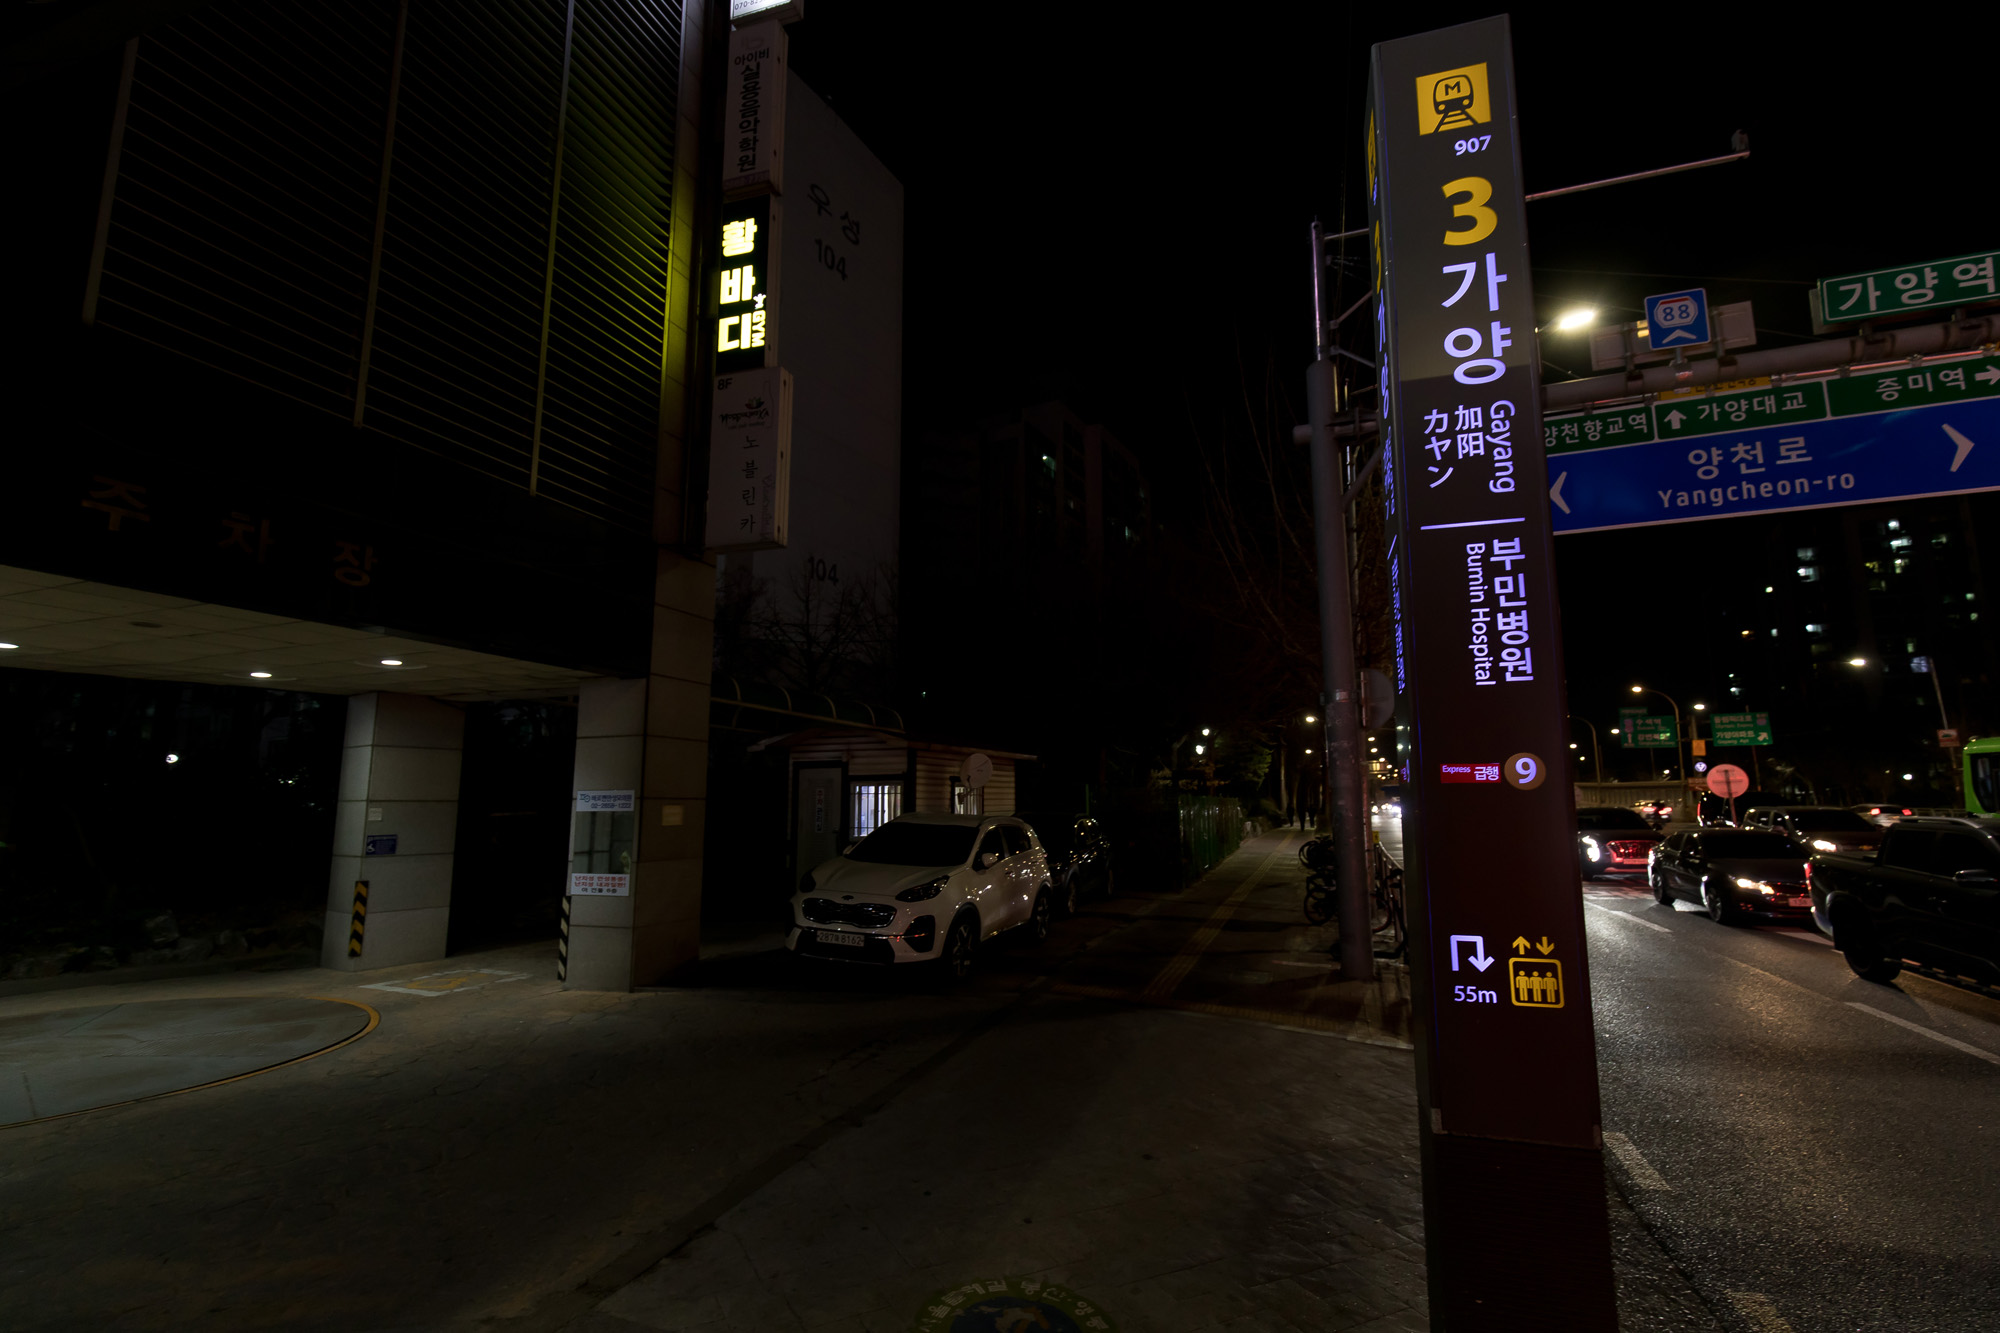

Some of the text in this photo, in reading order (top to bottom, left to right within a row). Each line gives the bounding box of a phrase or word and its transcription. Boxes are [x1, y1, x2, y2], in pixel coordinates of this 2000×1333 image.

[734, 48, 770, 66] 아이비
[738, 62, 761, 174] 실용음악학원
[1454, 134, 1492, 156] 907
[807, 184, 860, 246] 우성
[1441, 175, 1498, 246] 3
[814, 238, 848, 281] 104
[1837, 256, 1996, 312] 가양역
[751, 309, 766, 348] GYM
[1441, 252, 1513, 385] 가양
[1662, 304, 1691, 322] 88
[717, 378, 733, 390] 8F
[1875, 367, 1966, 402] 증미역
[1697, 391, 1807, 422] 가양대교
[1454, 404, 1485, 459] 加阳
[1484, 399, 1516, 493] Gayang
[1544, 412, 1649, 447] 양천향교역
[1423, 408, 1454, 488] カヤン
[740, 435, 760, 534] 노블린카
[1657, 472, 1856, 508] Yangcheon-ro
[807, 556, 839, 586] 104
[1466, 542, 1497, 686] Bumin Hospital
[1490, 536, 1534, 683] 부민병원
[1442, 764, 1471, 774] Express
[1473, 766, 1500, 781] 급행
[1514, 757, 1537, 784] 9
[841, 934, 862, 945] 8162
[1454, 985, 1497, 1004] 55m
